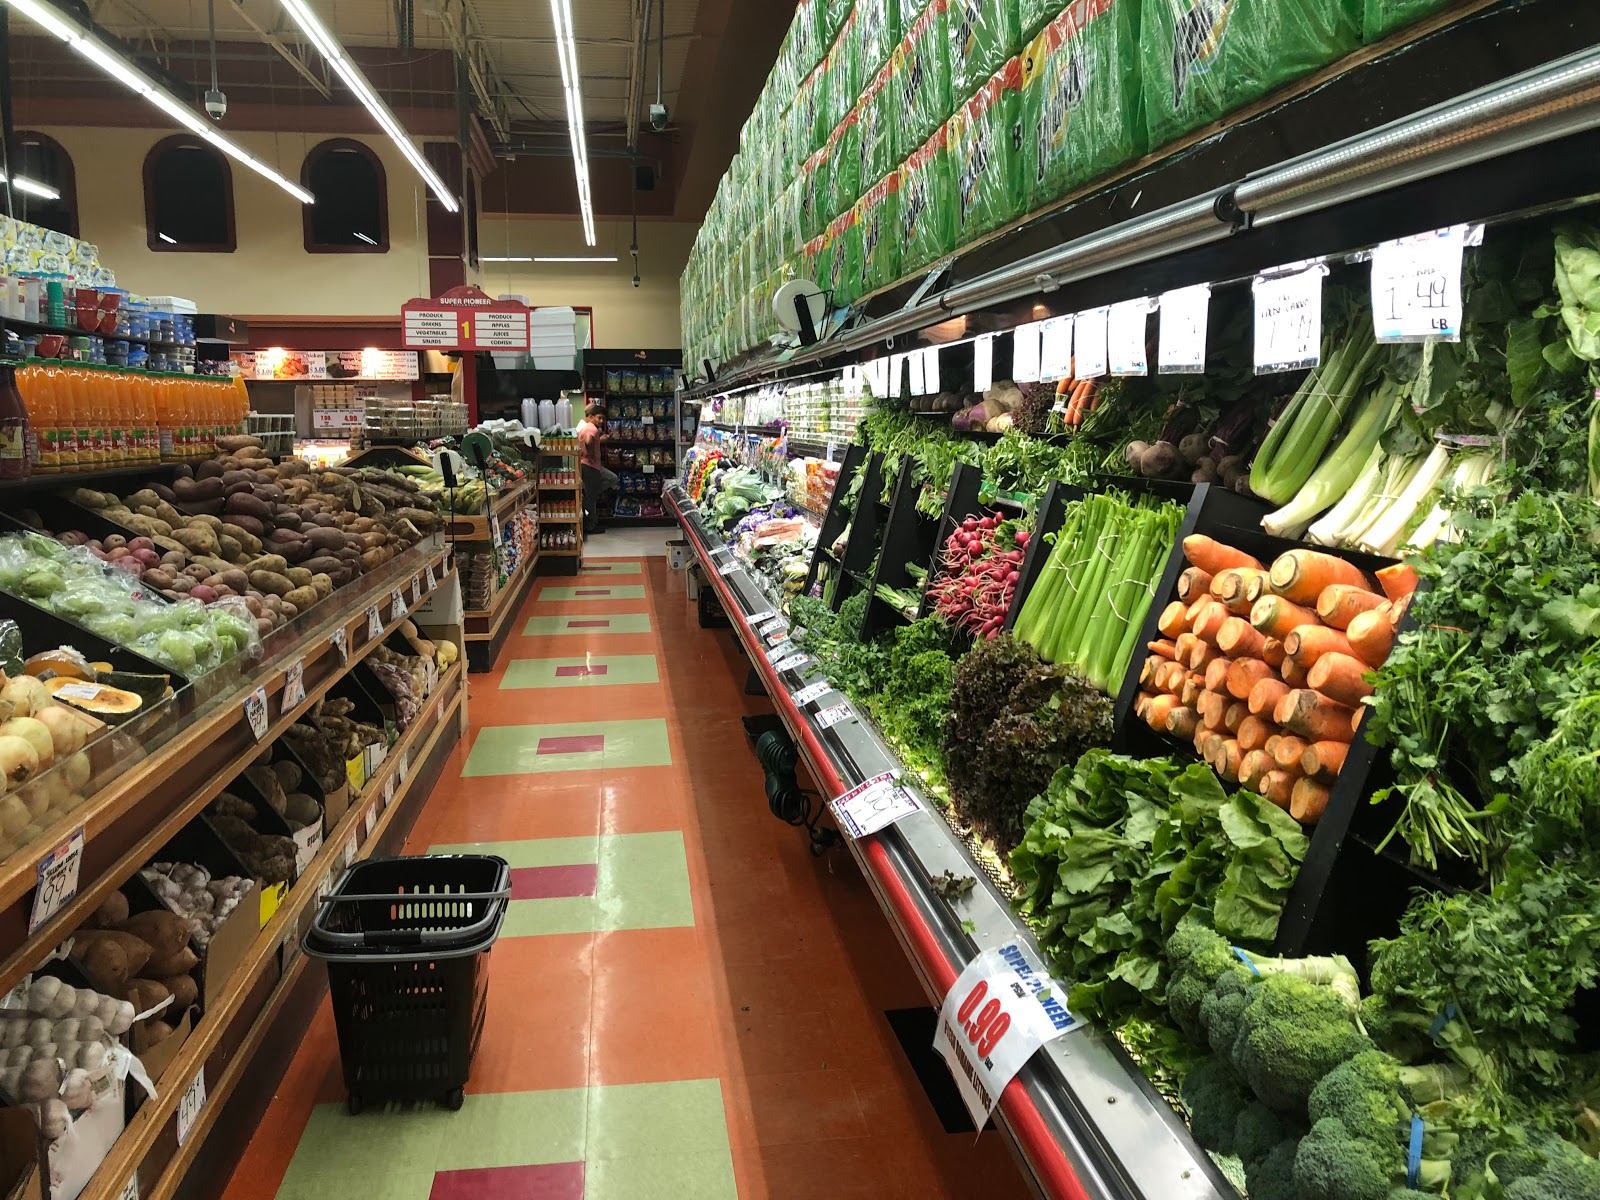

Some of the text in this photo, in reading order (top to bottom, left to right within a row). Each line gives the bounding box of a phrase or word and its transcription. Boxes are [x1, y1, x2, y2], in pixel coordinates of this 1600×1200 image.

[1386, 276, 1449, 320] 1.49
[461, 321, 470, 339] 1
[957, 980, 1011, 1059] 0.99
[1026, 977, 1076, 1031] PINEER
